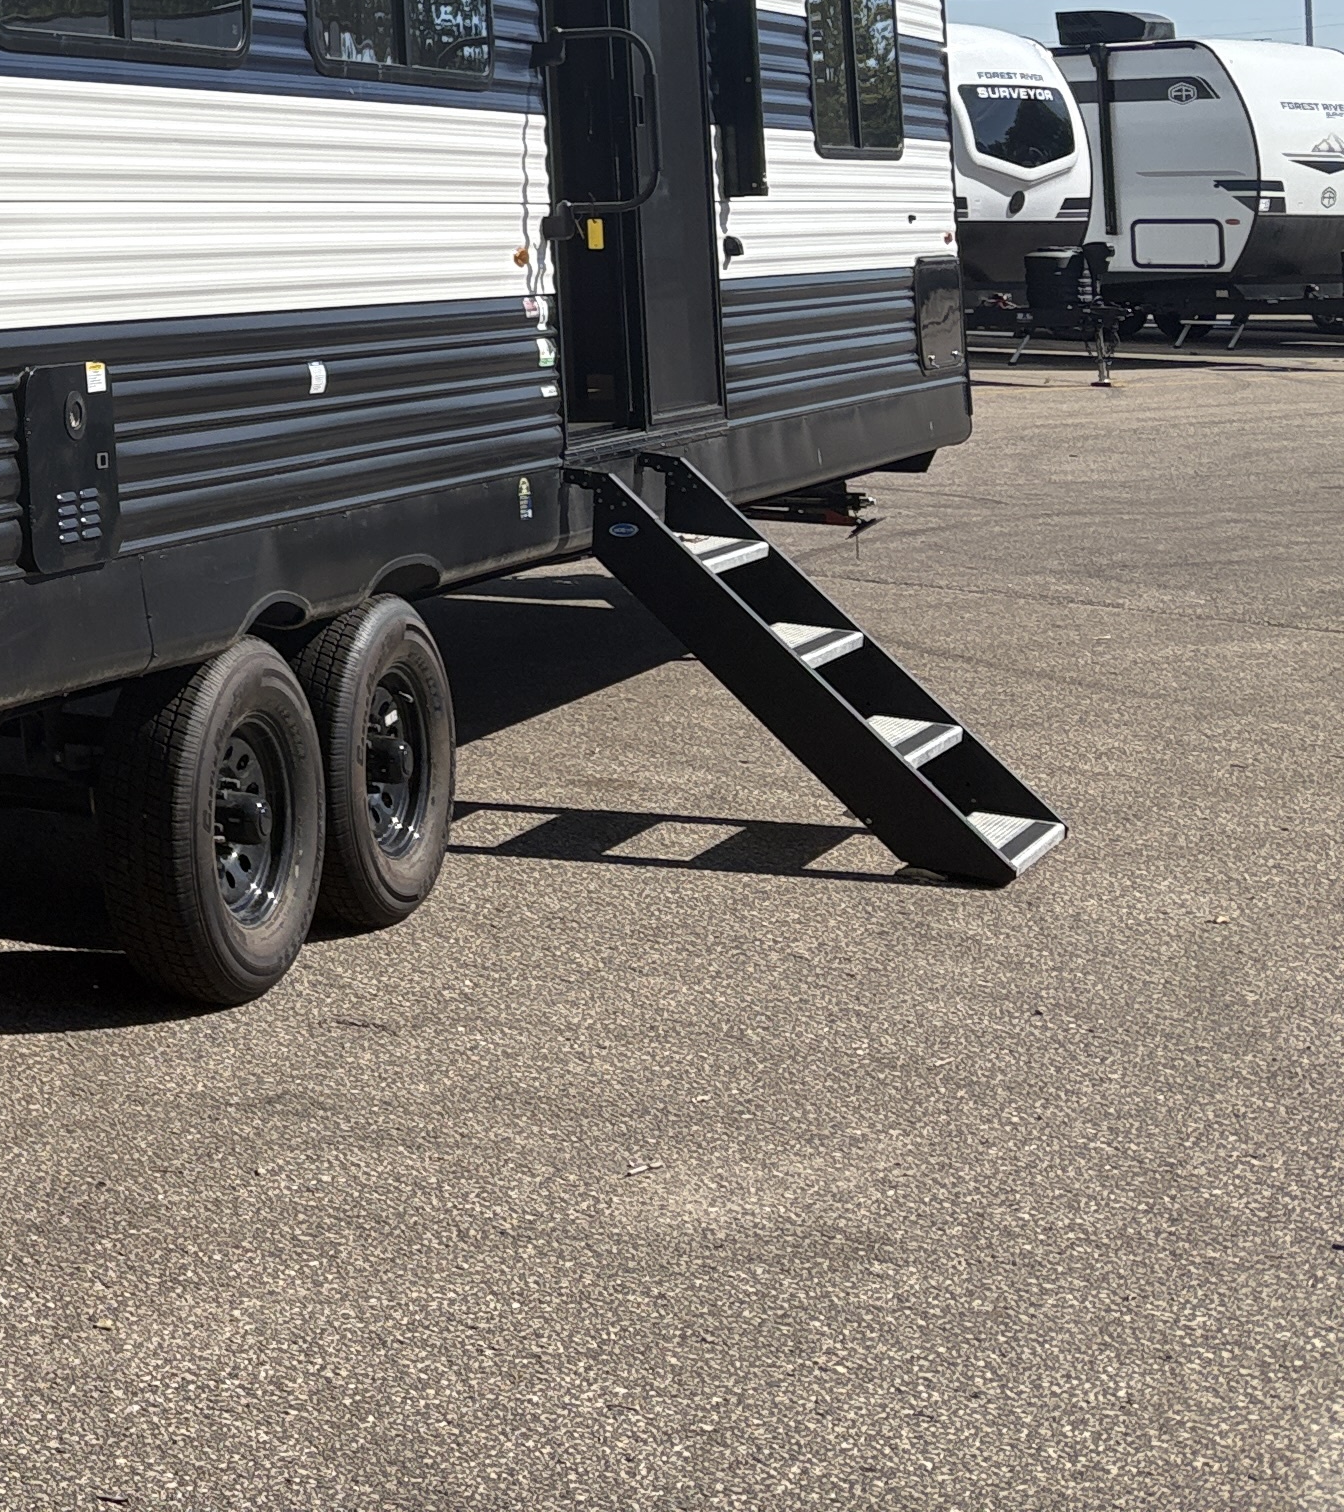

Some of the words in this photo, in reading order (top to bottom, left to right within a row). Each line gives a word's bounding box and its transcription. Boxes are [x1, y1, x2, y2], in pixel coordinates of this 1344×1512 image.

[977, 71, 1017, 80] FOREST
[1018, 72, 1045, 82] RIVER
[977, 86, 1054, 101] SURVEYOR
[1280, 102, 1319, 111] FOREST
